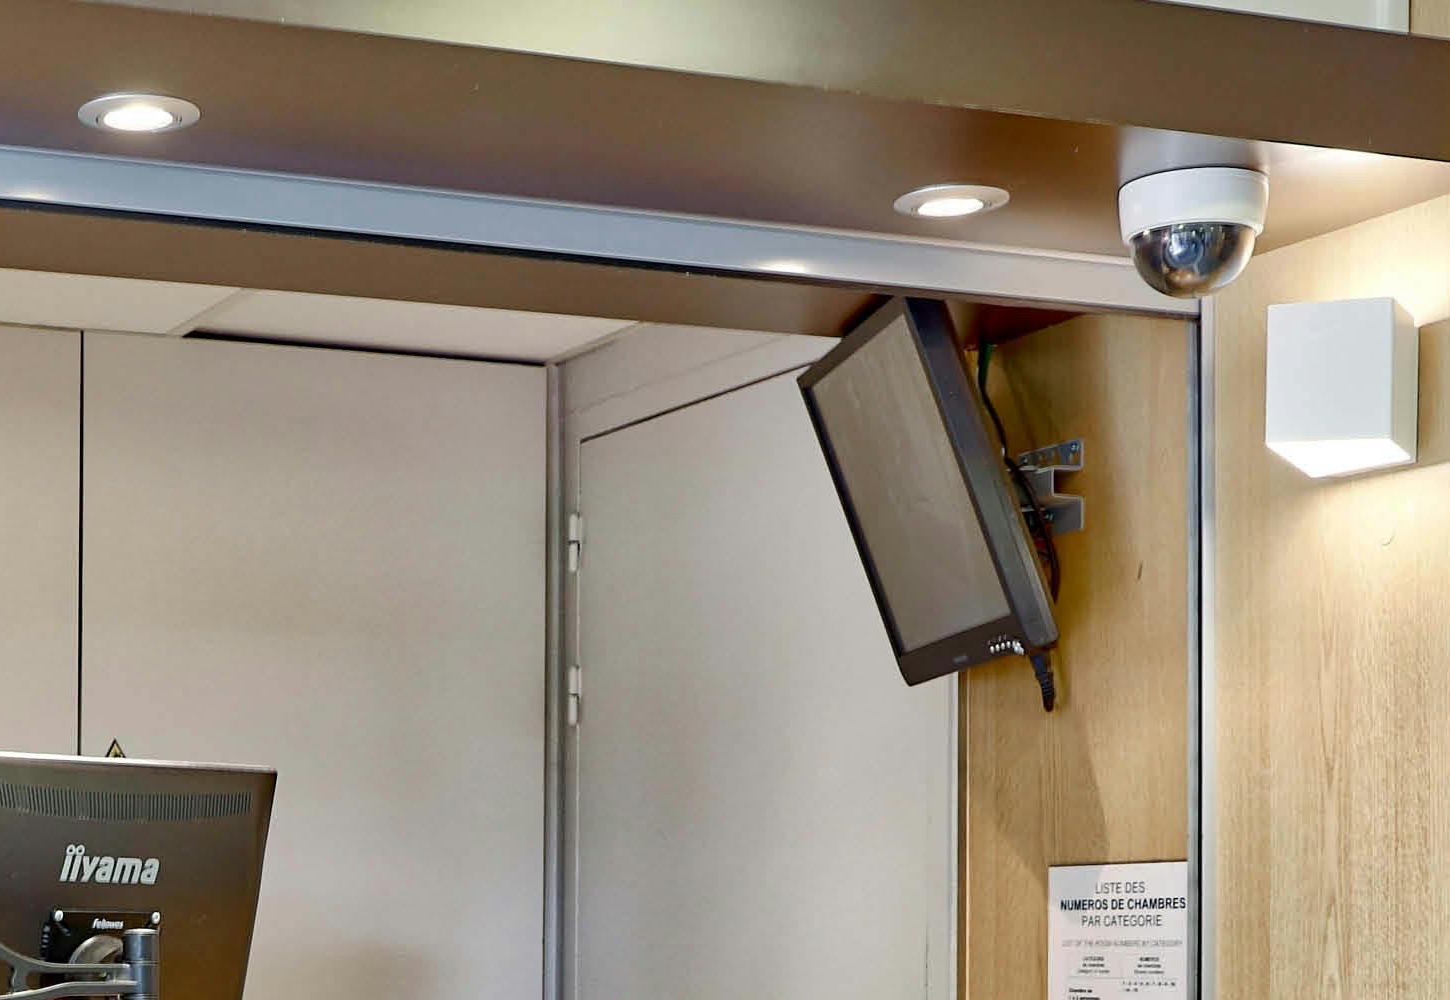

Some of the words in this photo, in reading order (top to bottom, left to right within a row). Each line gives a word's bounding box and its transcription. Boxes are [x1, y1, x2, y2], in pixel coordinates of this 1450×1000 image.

[60, 844, 161, 885] iiyama
[1095, 882, 1122, 894] LISTE
[1125, 881, 1145, 893] DES
[1061, 899, 1108, 910] NUMEROS
[1111, 899, 1124, 910] DE
[1127, 897, 1186, 909] CHAMBRES
[1082, 915, 1101, 926] PAR
[1104, 915, 1162, 927] CATEGORIE
